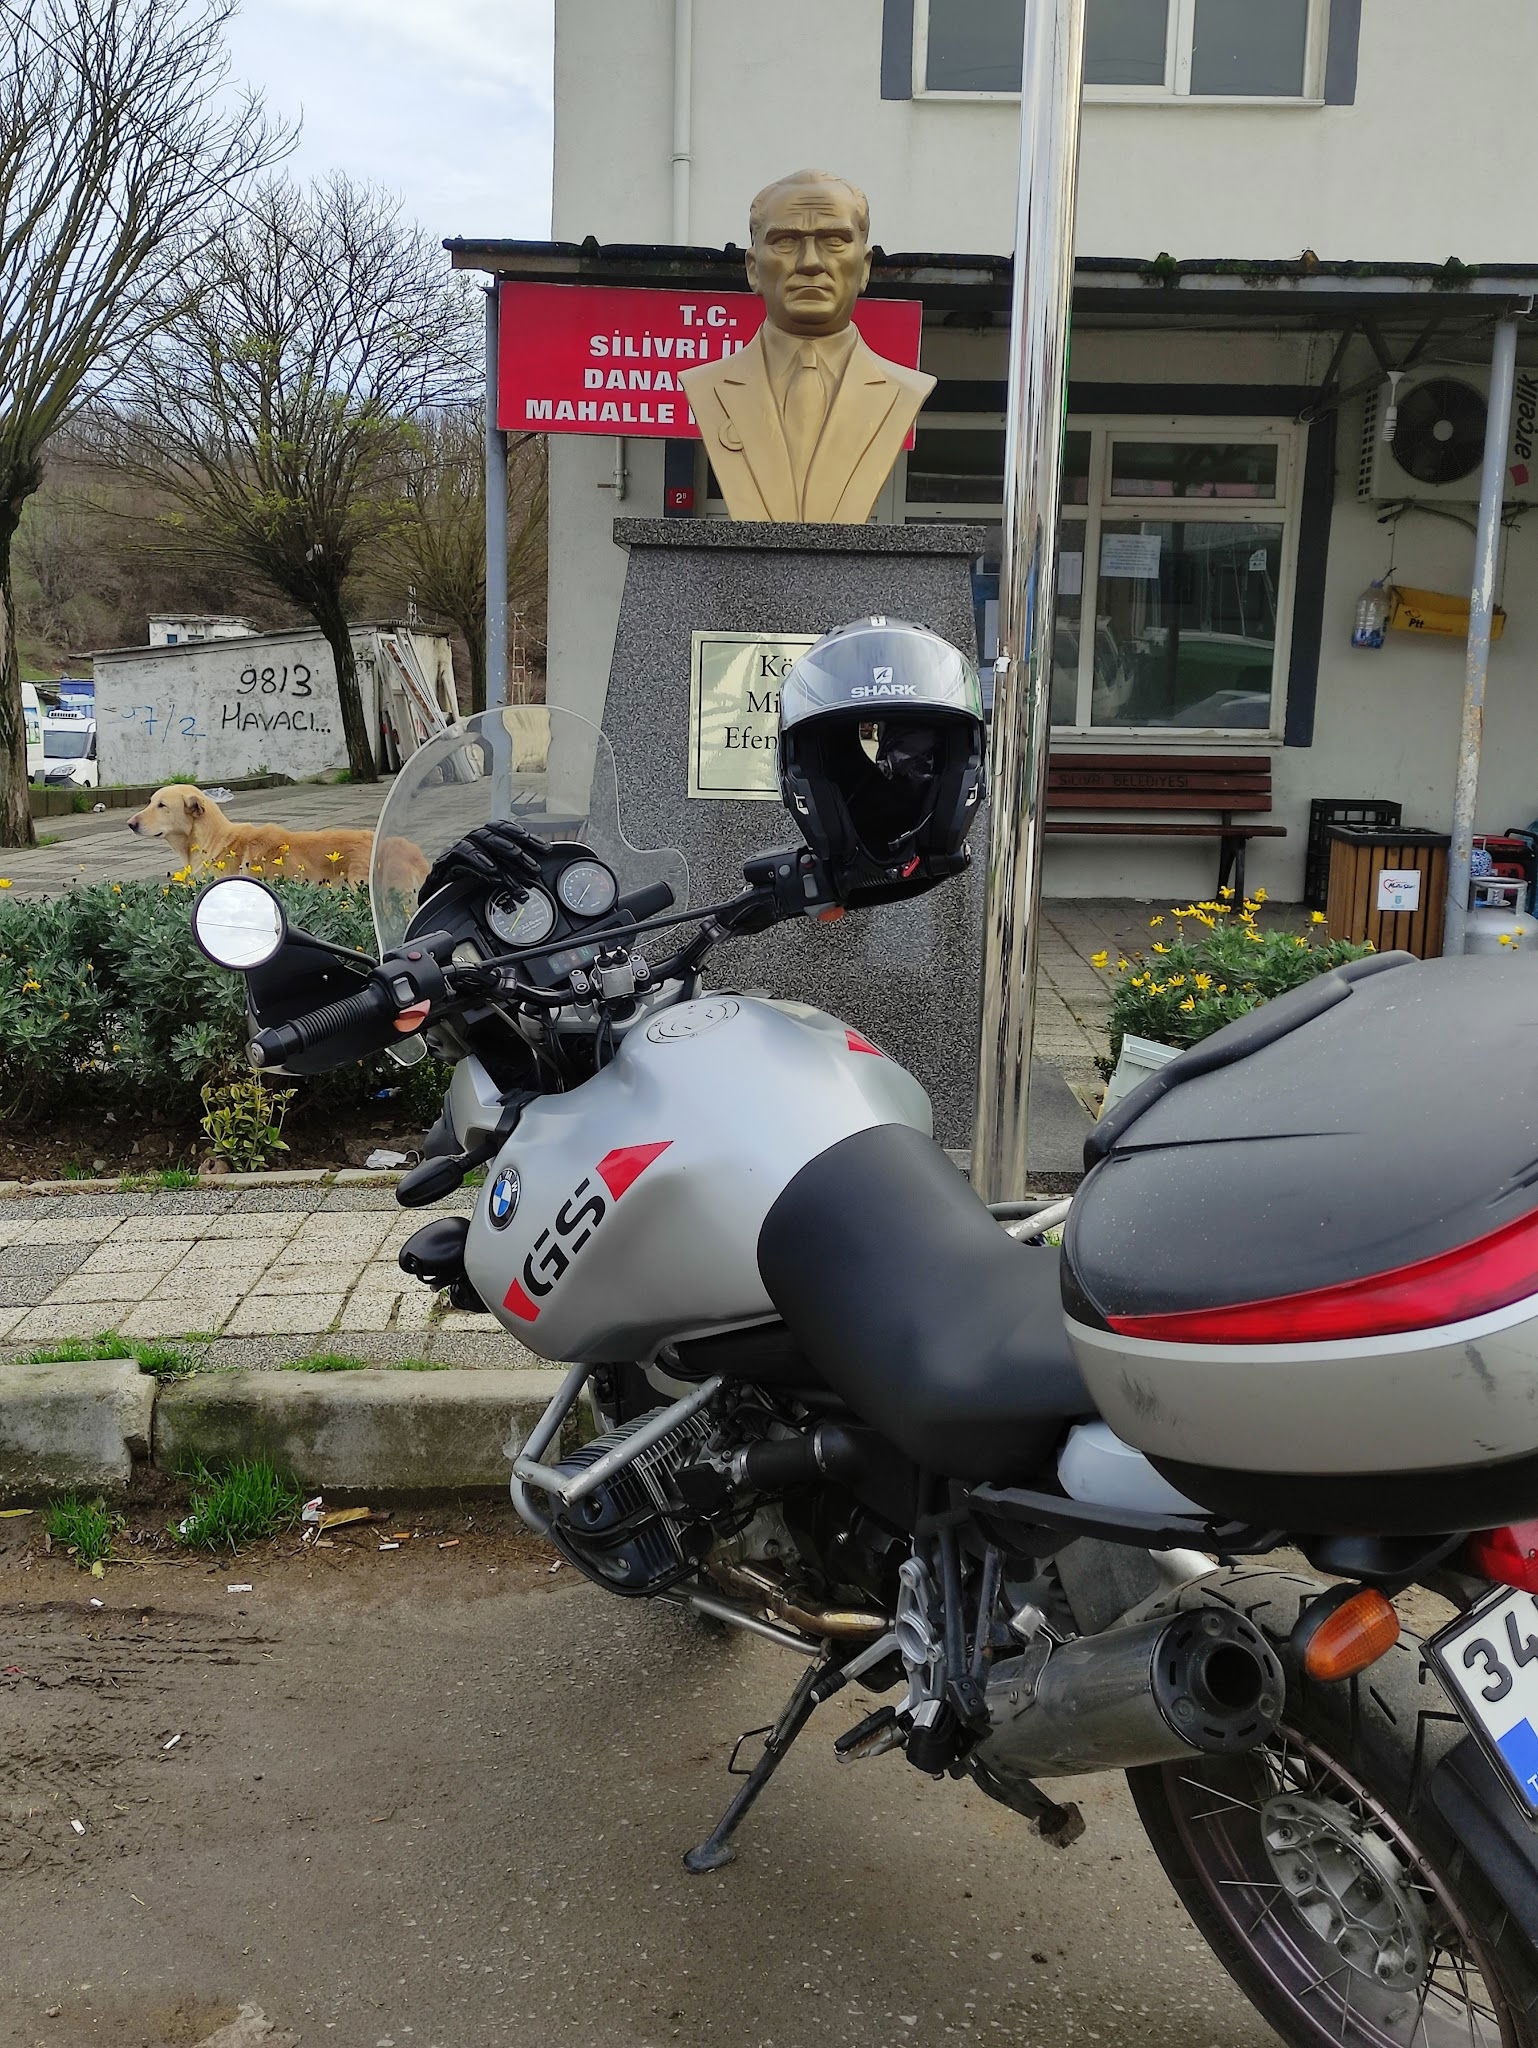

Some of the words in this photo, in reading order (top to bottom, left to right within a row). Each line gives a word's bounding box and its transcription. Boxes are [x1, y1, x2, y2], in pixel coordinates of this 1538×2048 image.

[679, 305, 737, 327] T.C.
[589, 330, 708, 360] SİLİVRİ
[584, 369, 685, 391] DANA
[525, 399, 675, 424] MAHALLE
[850, 684, 917, 698] SHARK
[724, 726, 778, 749] Efen
[523, 1177, 606, 1297] GS
[1526, 1773, 1538, 1793] T
